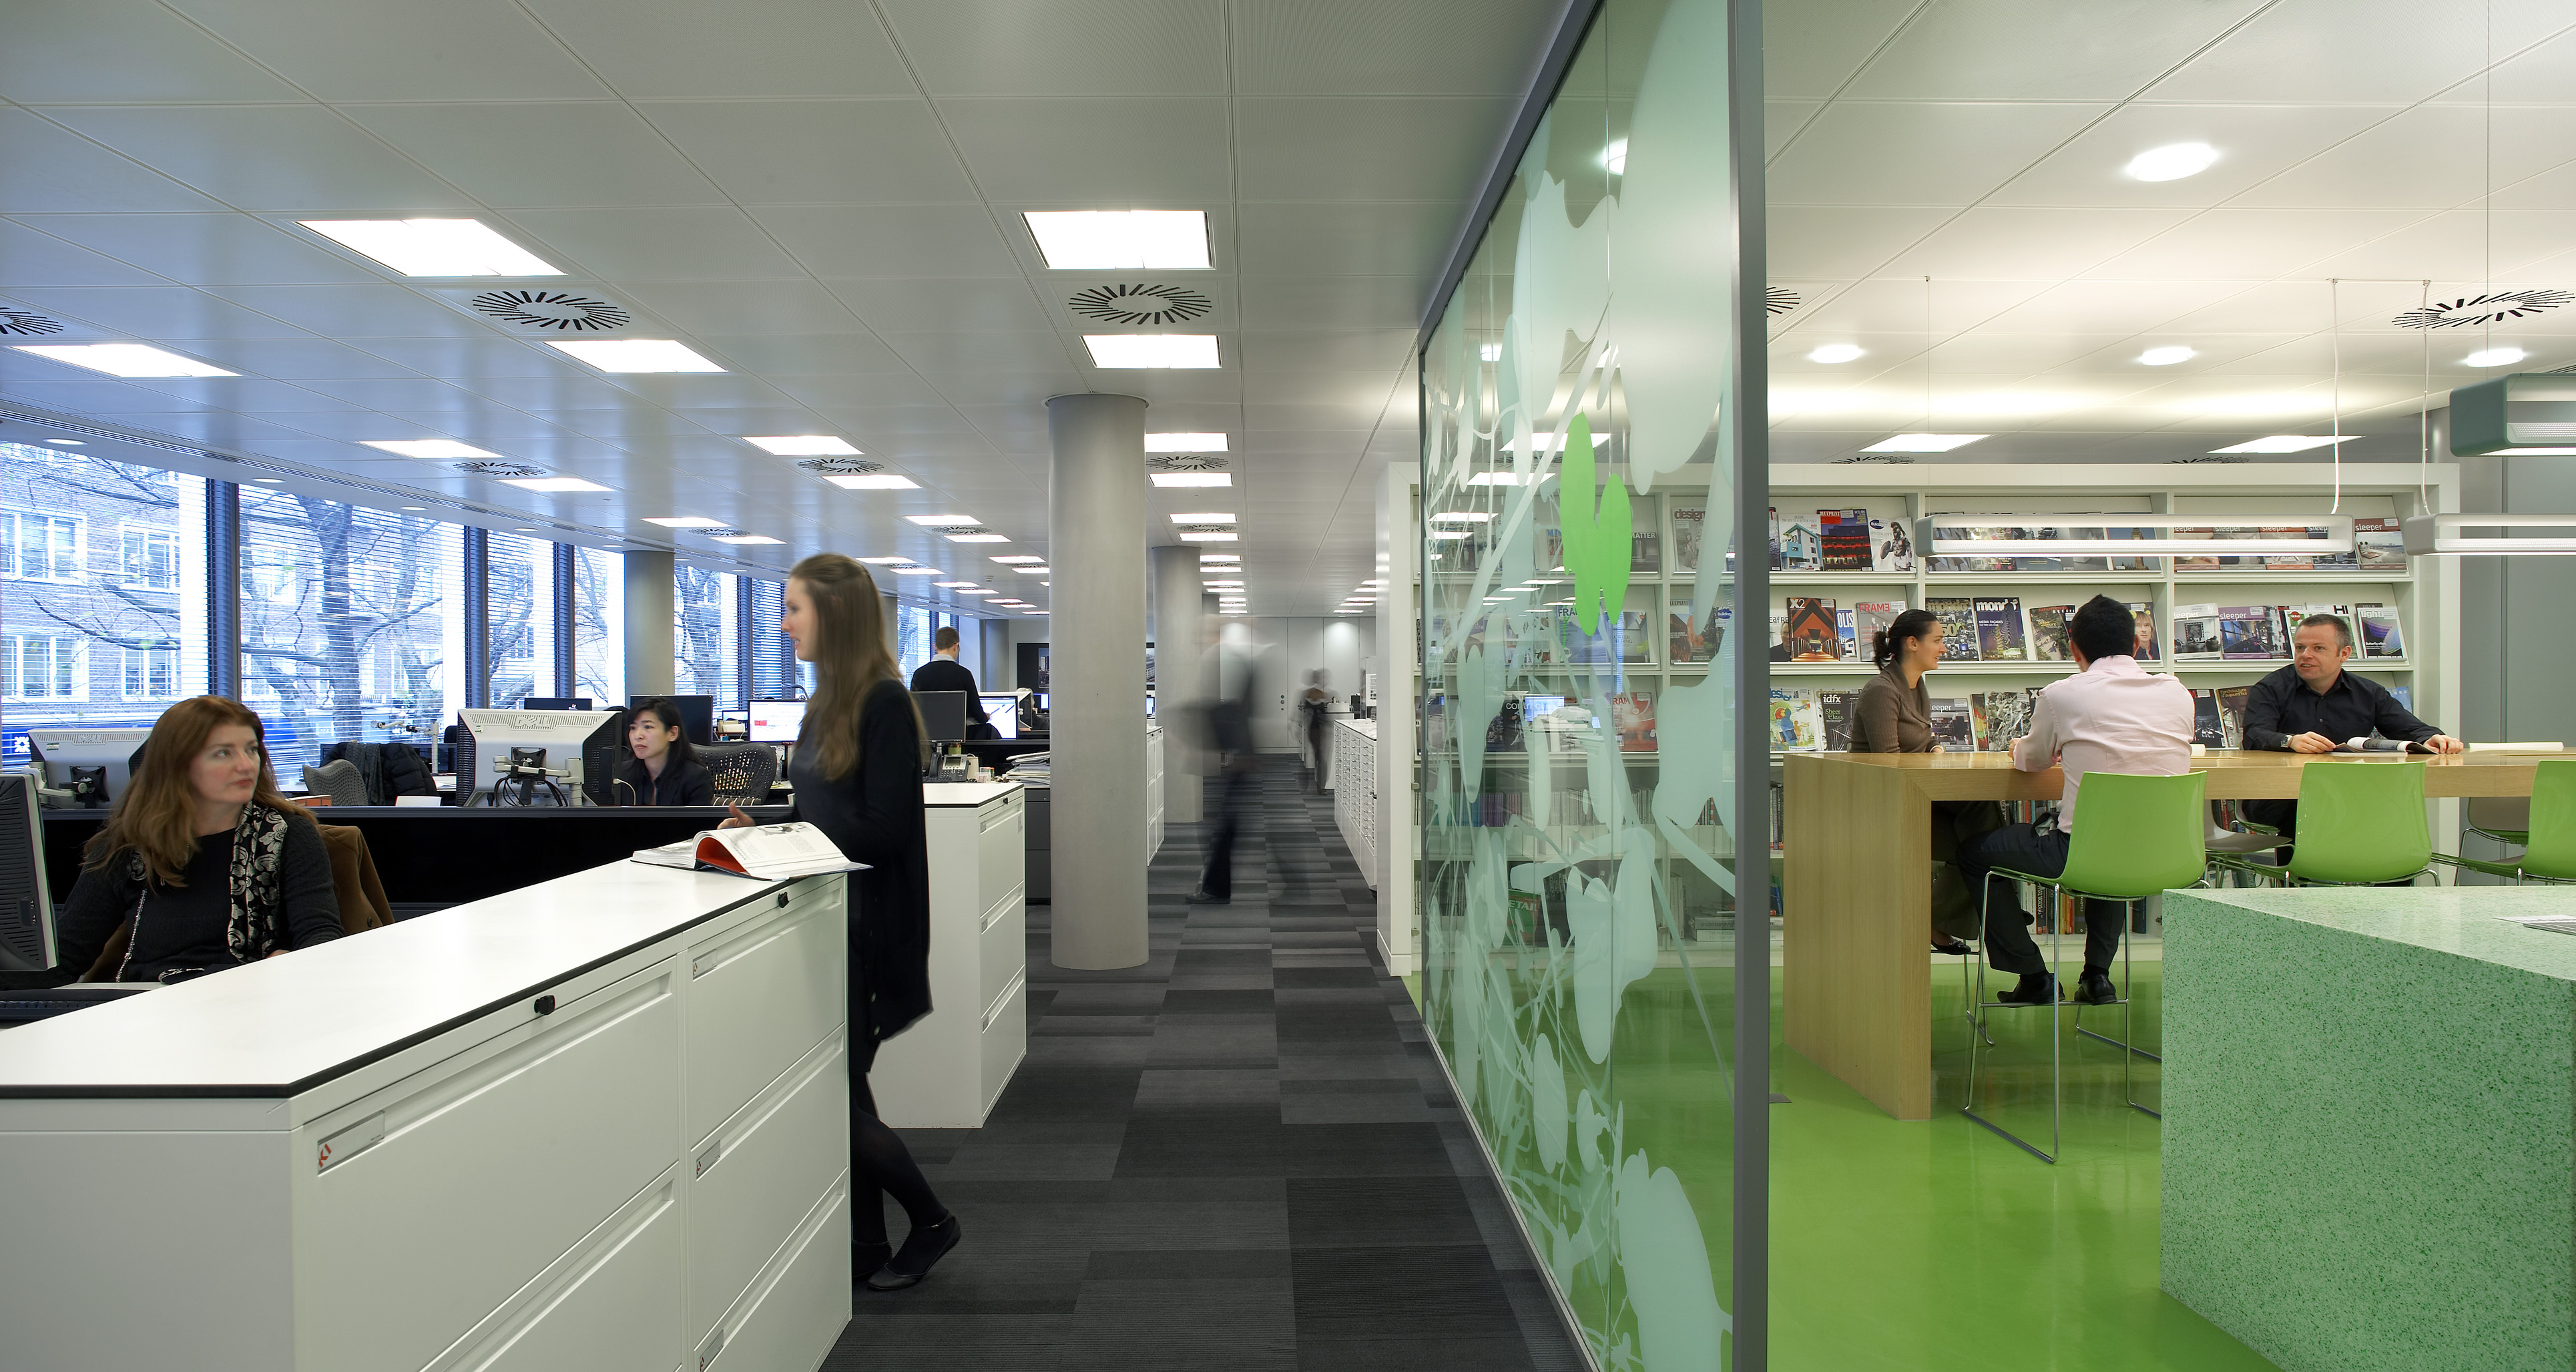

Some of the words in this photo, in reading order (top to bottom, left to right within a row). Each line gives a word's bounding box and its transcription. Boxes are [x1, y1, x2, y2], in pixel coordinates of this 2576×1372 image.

[2355, 524, 2382, 532] sleeper
[2220, 612, 2247, 621] sleeper
[1823, 695, 1841, 703] idfx
[1930, 704, 1952, 712] eeper
